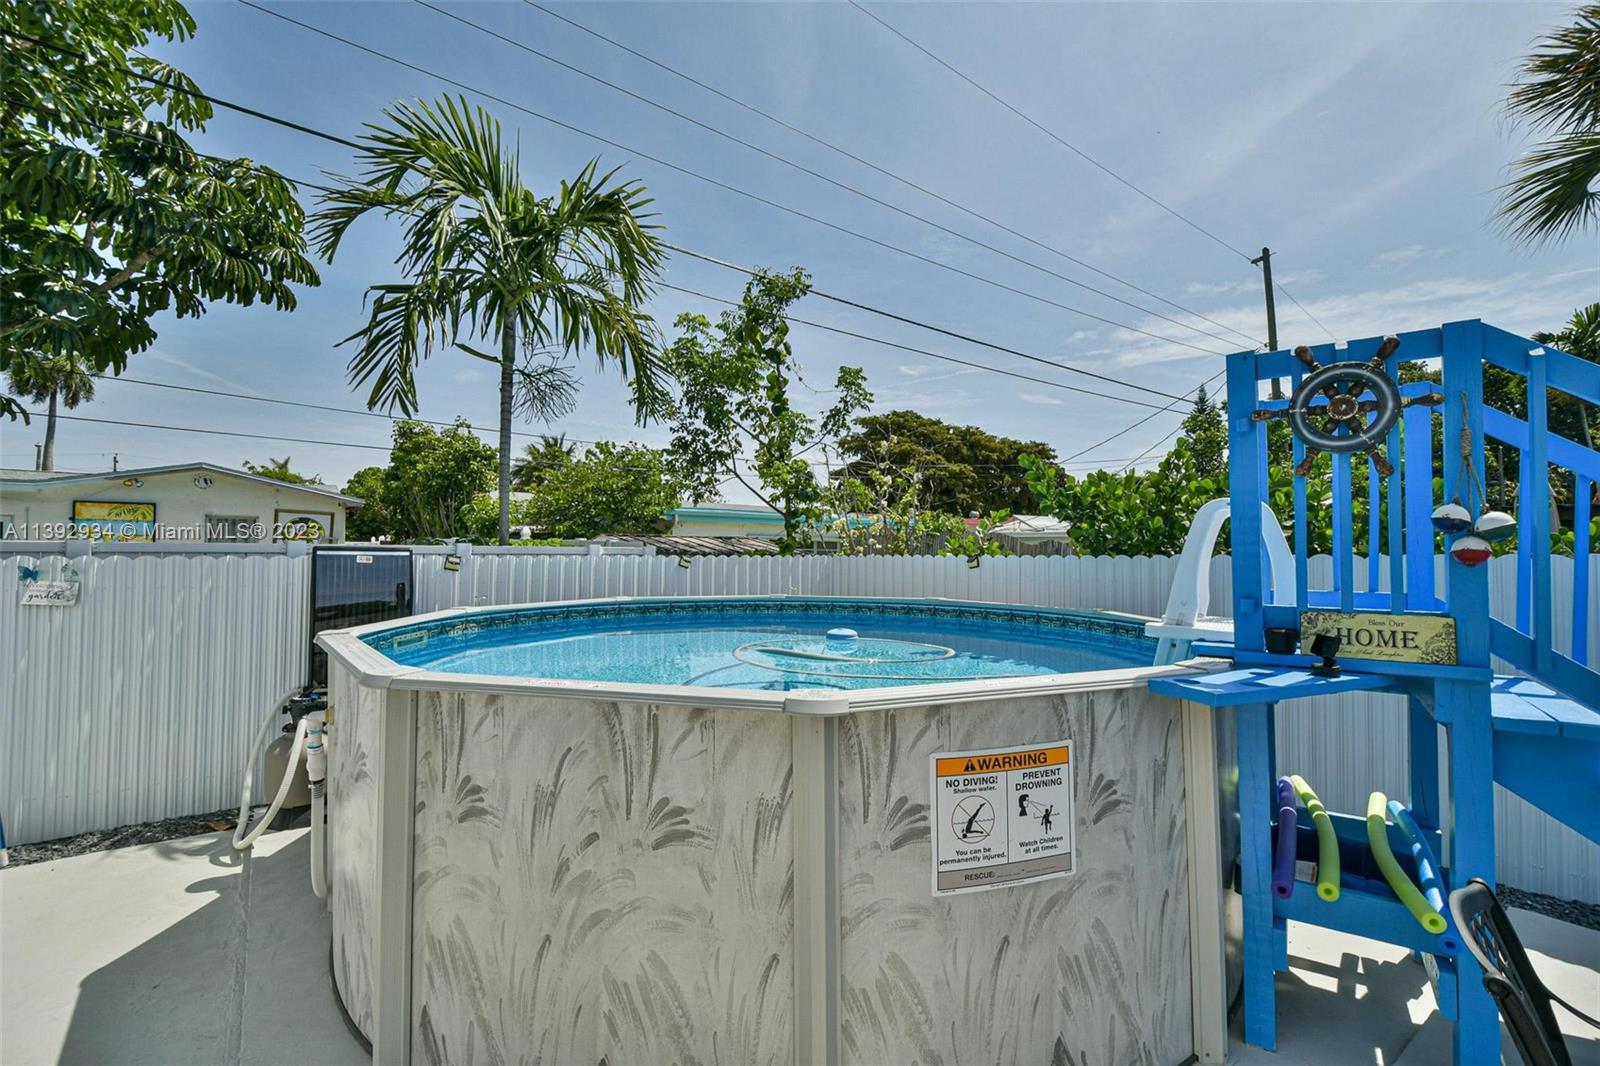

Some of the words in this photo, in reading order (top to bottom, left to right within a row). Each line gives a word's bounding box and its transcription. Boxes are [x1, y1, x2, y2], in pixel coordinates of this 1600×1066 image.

[1389, 619, 1405, 628] Our
[1335, 627, 1420, 649] HOME
[977, 752, 1048, 771] WARNING
[1022, 768, 1062, 780] PREVENT
[945, 779, 960, 788] NO
[963, 776, 998, 787] DIVING!
[1015, 777, 1063, 791] DROWNING
[978, 785, 997, 793] water.
[1019, 839, 1038, 848] Watch
[1039, 836, 1064, 845] Children
[1041, 843, 1059, 852] times.
[939, 854, 981, 866] permanently
[982, 851, 1007, 861] injured.
[955, 849, 968, 857] You
